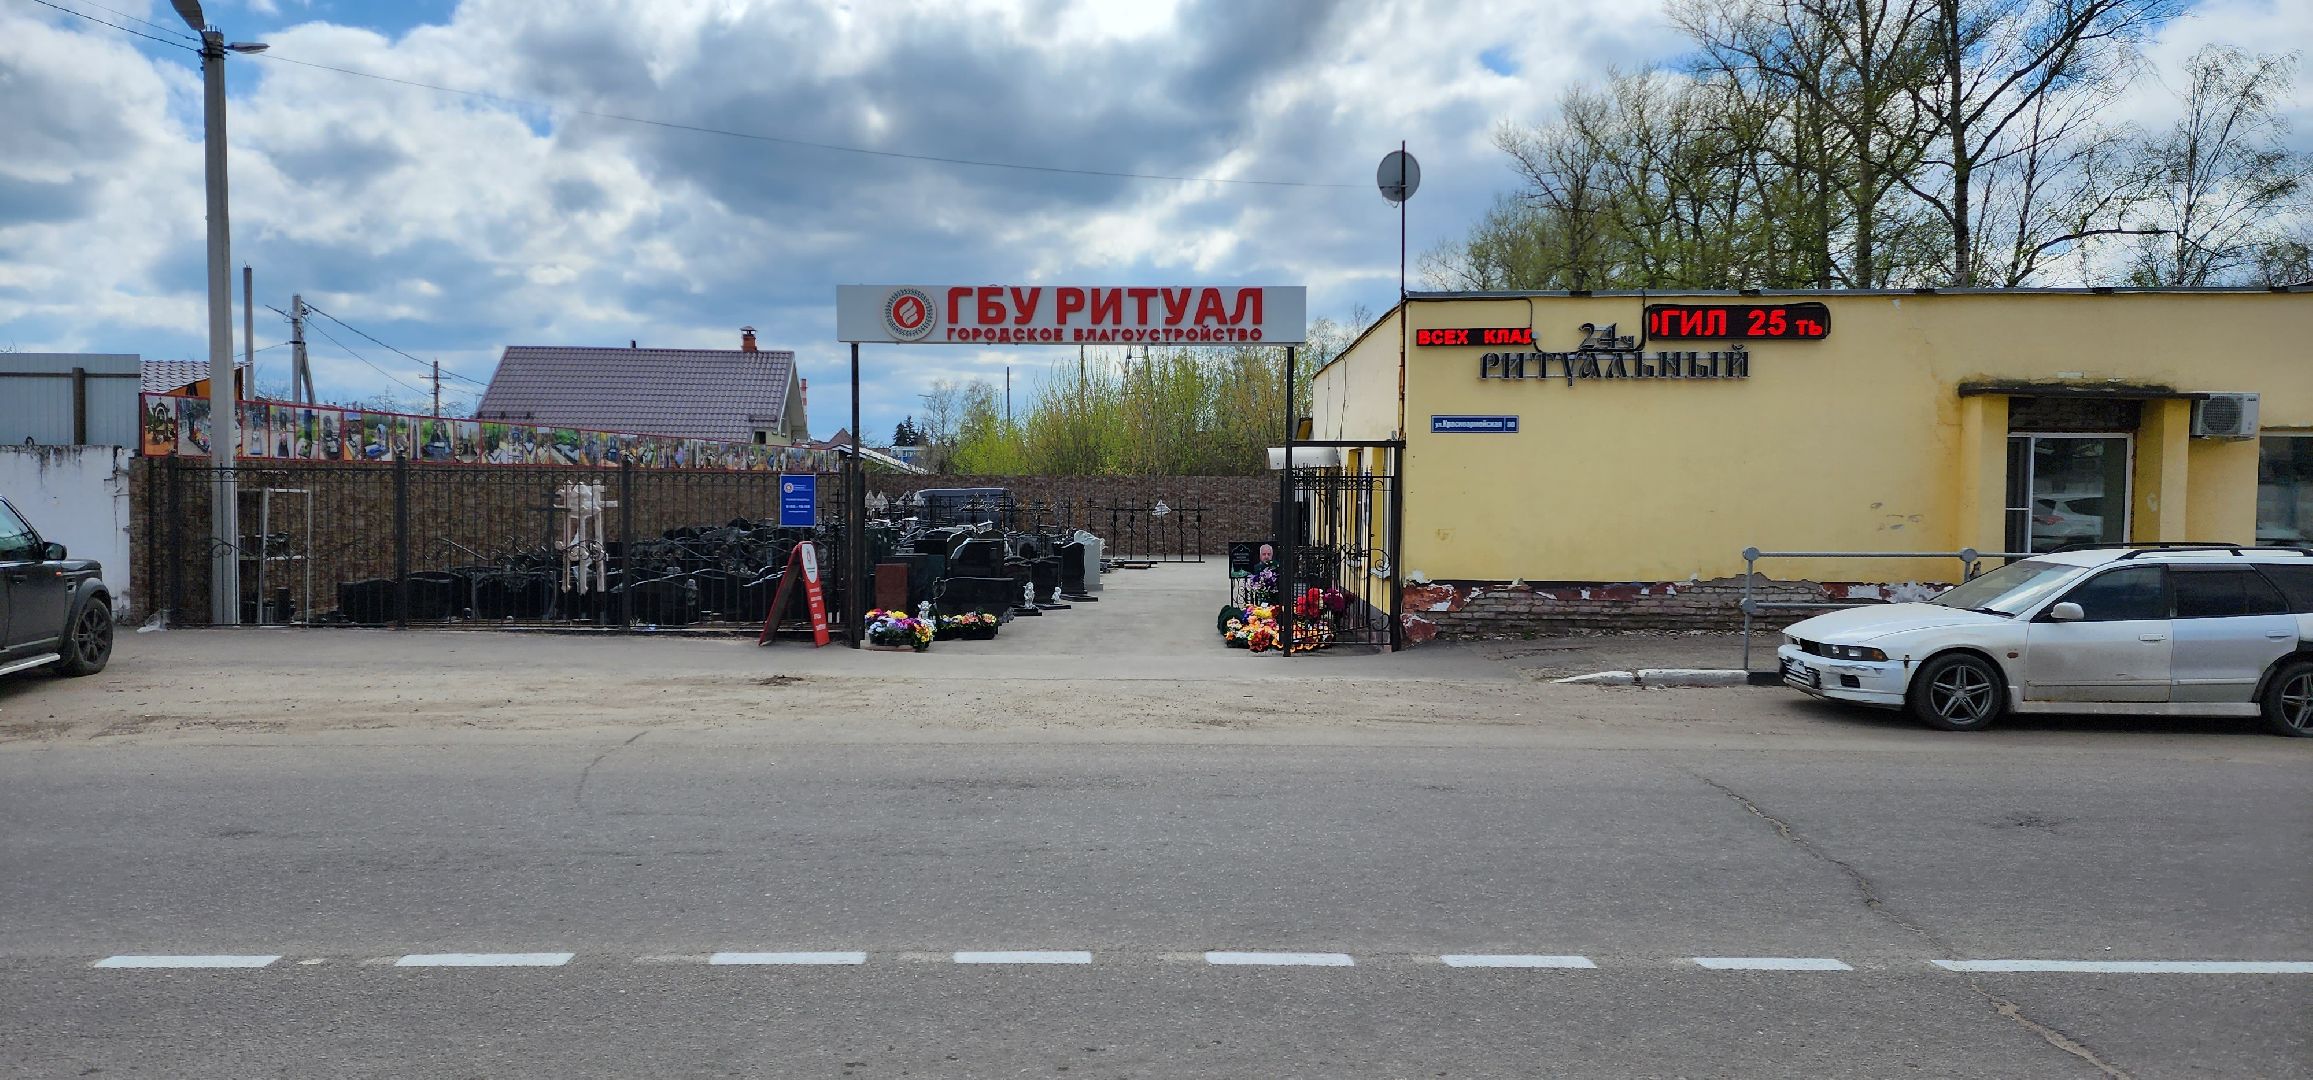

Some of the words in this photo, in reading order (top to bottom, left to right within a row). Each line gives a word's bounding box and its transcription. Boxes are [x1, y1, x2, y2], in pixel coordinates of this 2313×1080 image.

[947, 287, 1041, 326] ГБУ
[1056, 287, 1264, 326] РИТУАЛ
[947, 328, 1064, 342] ГОРОДСКОЕ
[1073, 325, 1263, 343] БЛАГОУСТРОЙСТВО
[1417, 328, 1469, 346] ВСЕХ
[1746, 308, 1788, 337] 25
[1479, 343, 1752, 388] РИТУАЛЬНЫЙ
